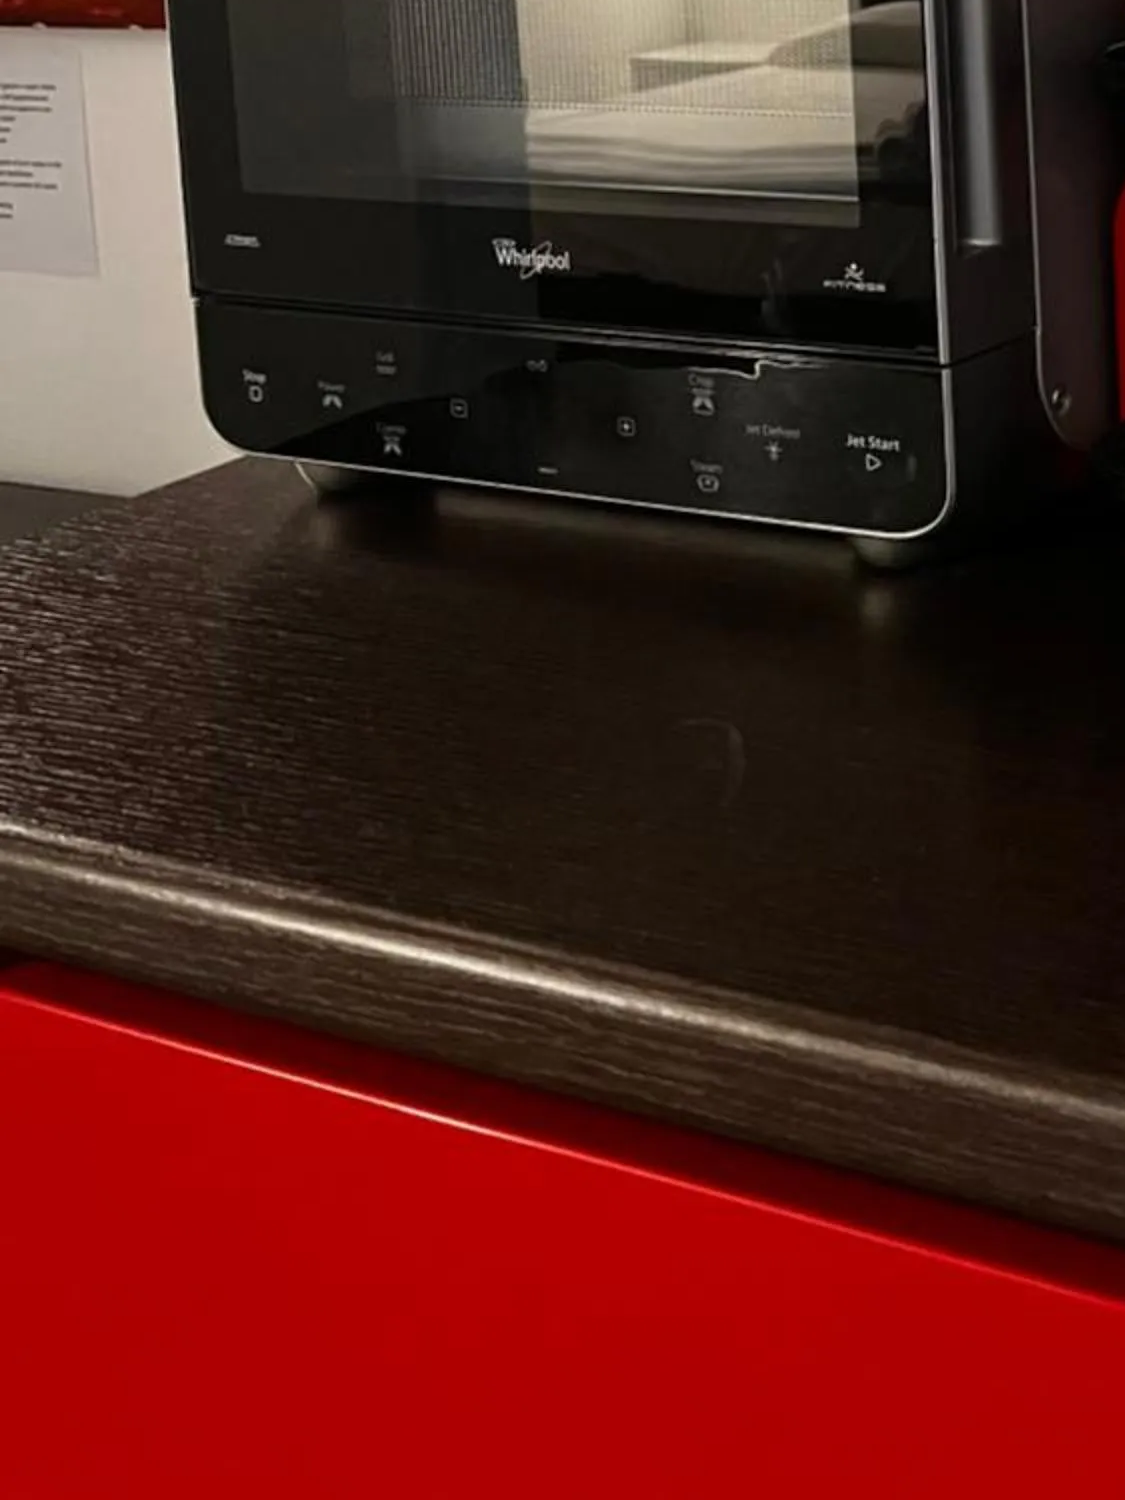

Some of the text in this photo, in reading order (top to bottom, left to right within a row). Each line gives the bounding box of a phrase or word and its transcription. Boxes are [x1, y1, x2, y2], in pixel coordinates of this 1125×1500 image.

[493, 241, 571, 277] Whirlpool
[846, 432, 901, 453] Jet Start
